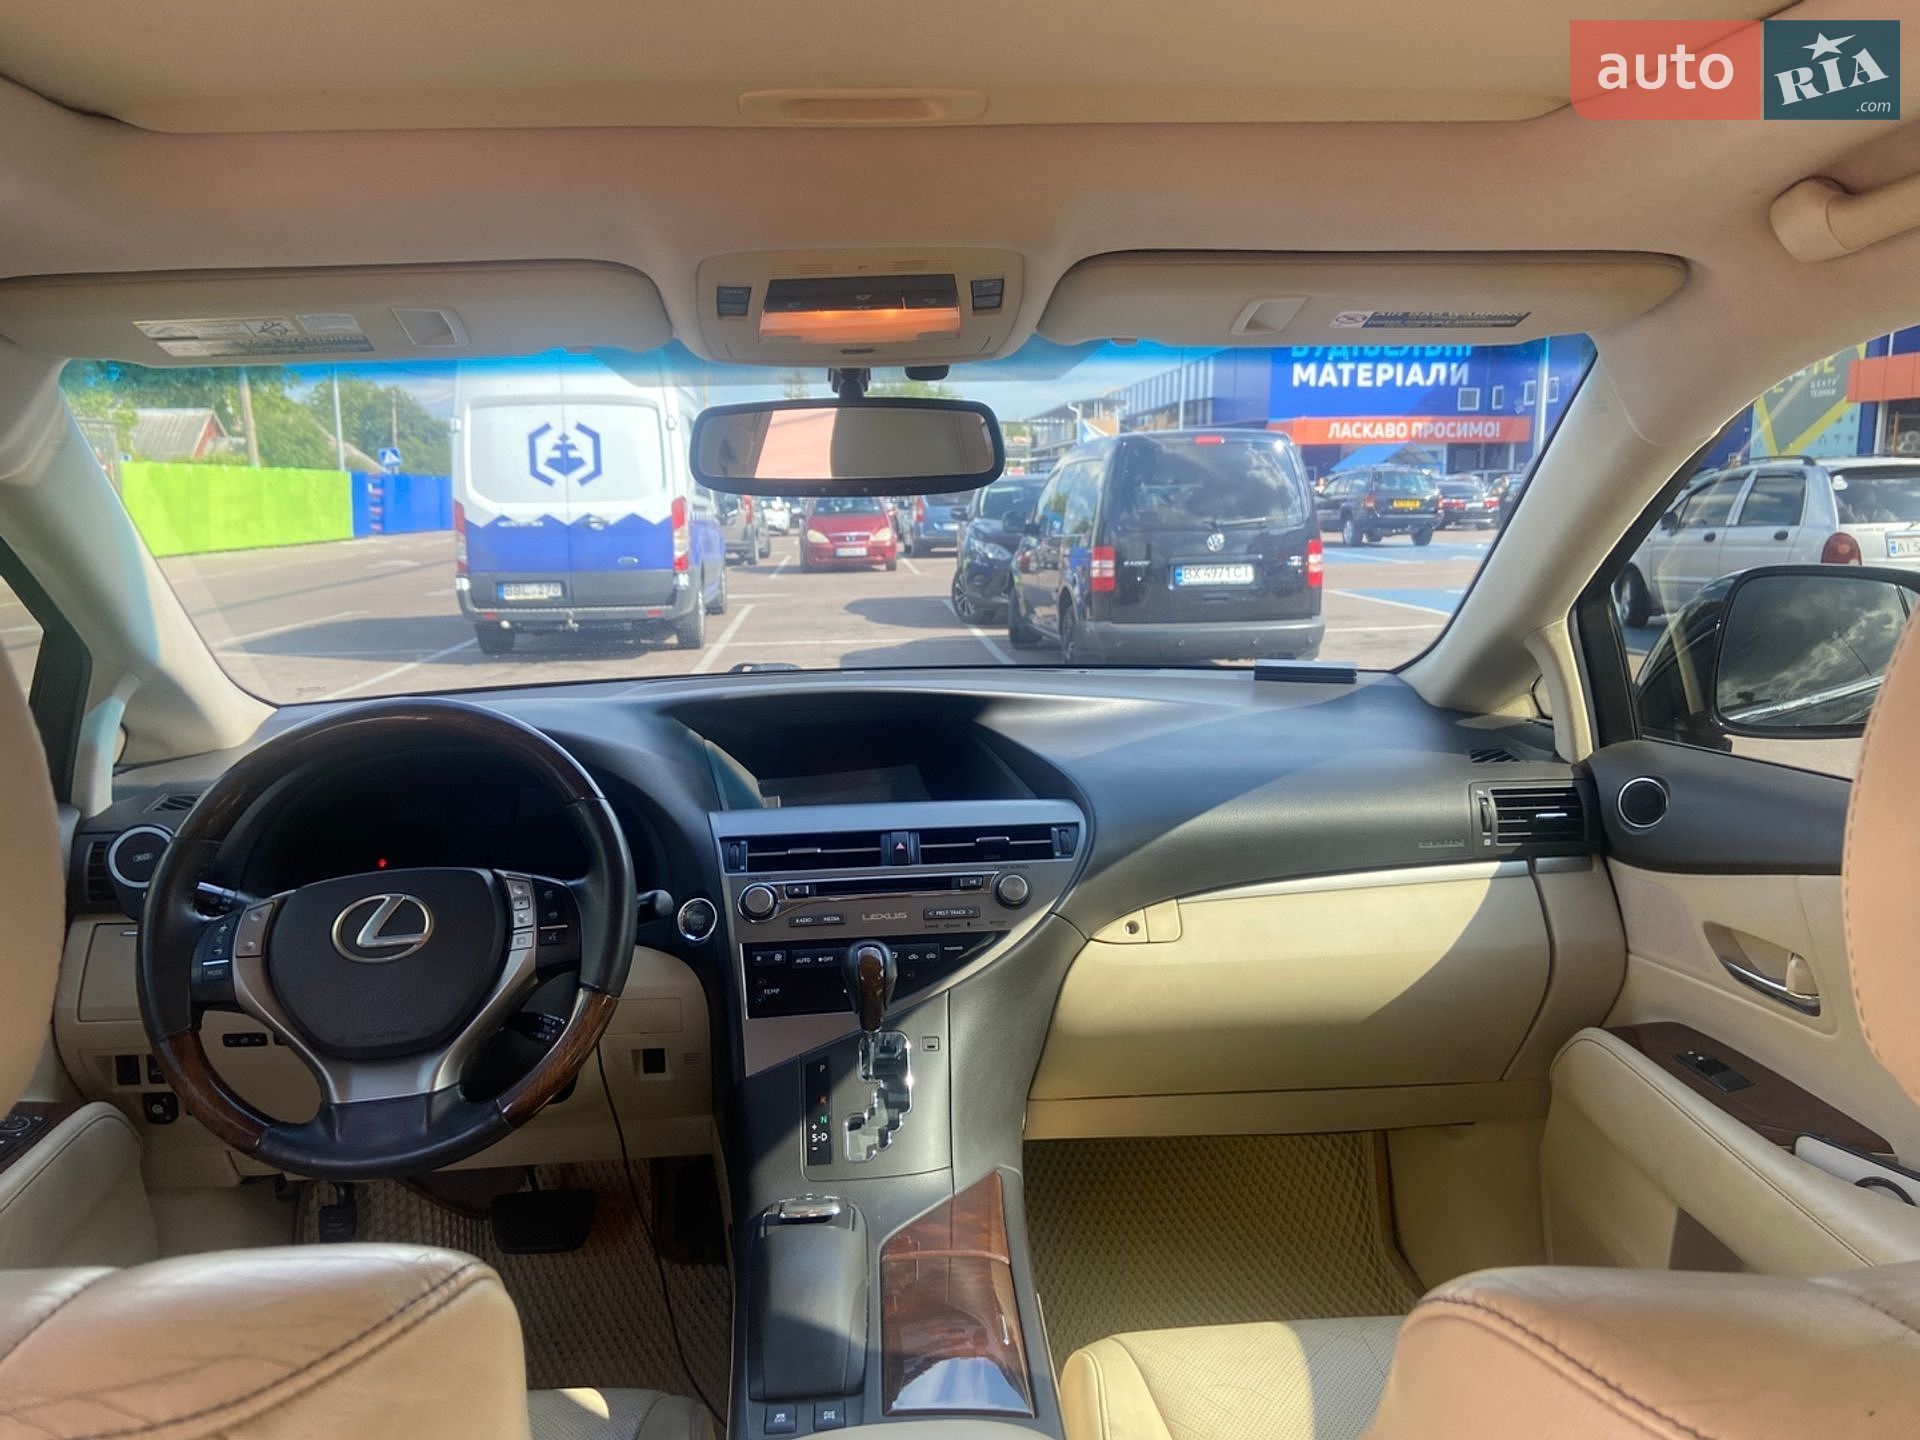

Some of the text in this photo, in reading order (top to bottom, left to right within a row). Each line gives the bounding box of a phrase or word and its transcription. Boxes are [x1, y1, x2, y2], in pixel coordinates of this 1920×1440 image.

[1292, 362, 1470, 387] МАТЕРІАЛИ
[1327, 421, 1500, 439] ЛАСКАВО ПРОСИМО!
[861, 911, 908, 921] LEXUS
